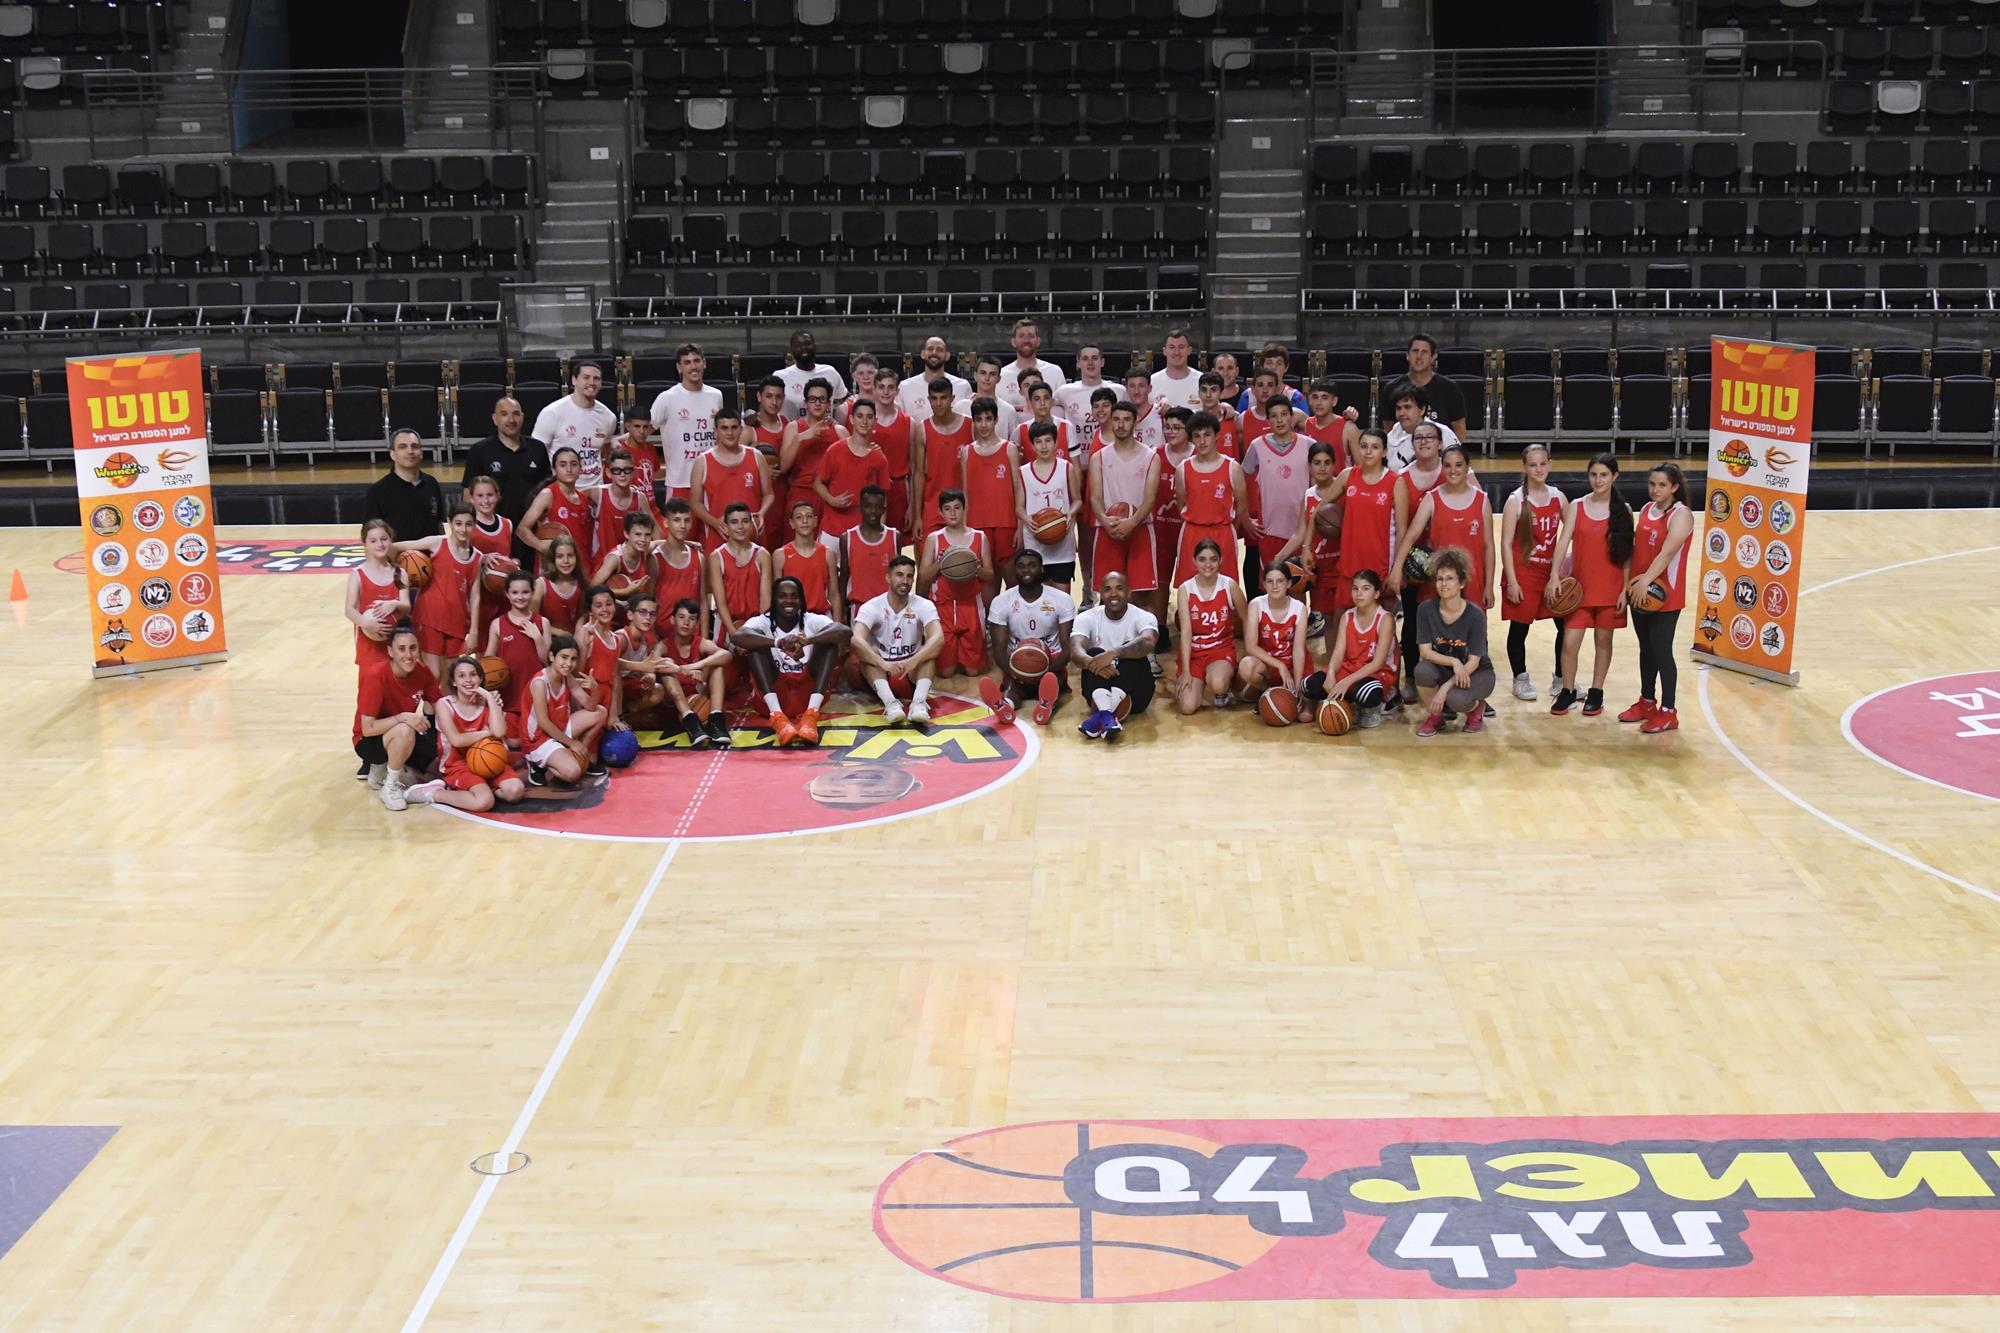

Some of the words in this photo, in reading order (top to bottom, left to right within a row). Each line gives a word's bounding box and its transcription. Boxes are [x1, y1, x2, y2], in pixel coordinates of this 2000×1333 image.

[1722, 379, 1799, 420] טוטו
[87, 390, 190, 429] טוטו
[696, 419, 707, 430] 73
[1720, 414, 1748, 428] בישראל
[1749, 422, 1776, 433] הספורט
[131, 429, 167, 440] הספורט
[168, 424, 191, 438] למען
[1777, 424, 1796, 436] למען
[92, 432, 129, 443] בישראל
[582, 437, 592, 447] 31
[1717, 450, 1750, 465] Winner
[95, 467, 138, 478] Winner
[1045, 495, 1050, 507] 1
[1540, 517, 1550, 531] 11
[262, 557, 367, 571] ליג
[147, 587, 166, 600] NZ
[1739, 585, 1752, 601] NZ
[1030, 619, 1036, 630] 0
[1201, 611, 1218, 626] 24
[893, 627, 902, 639] 12
[636, 729, 1004, 761] Winn
[1348, 1151, 2000, 1203] nner
[1093, 1155, 1311, 1224] סל
[1397, 1210, 1724, 1279] ליגת
